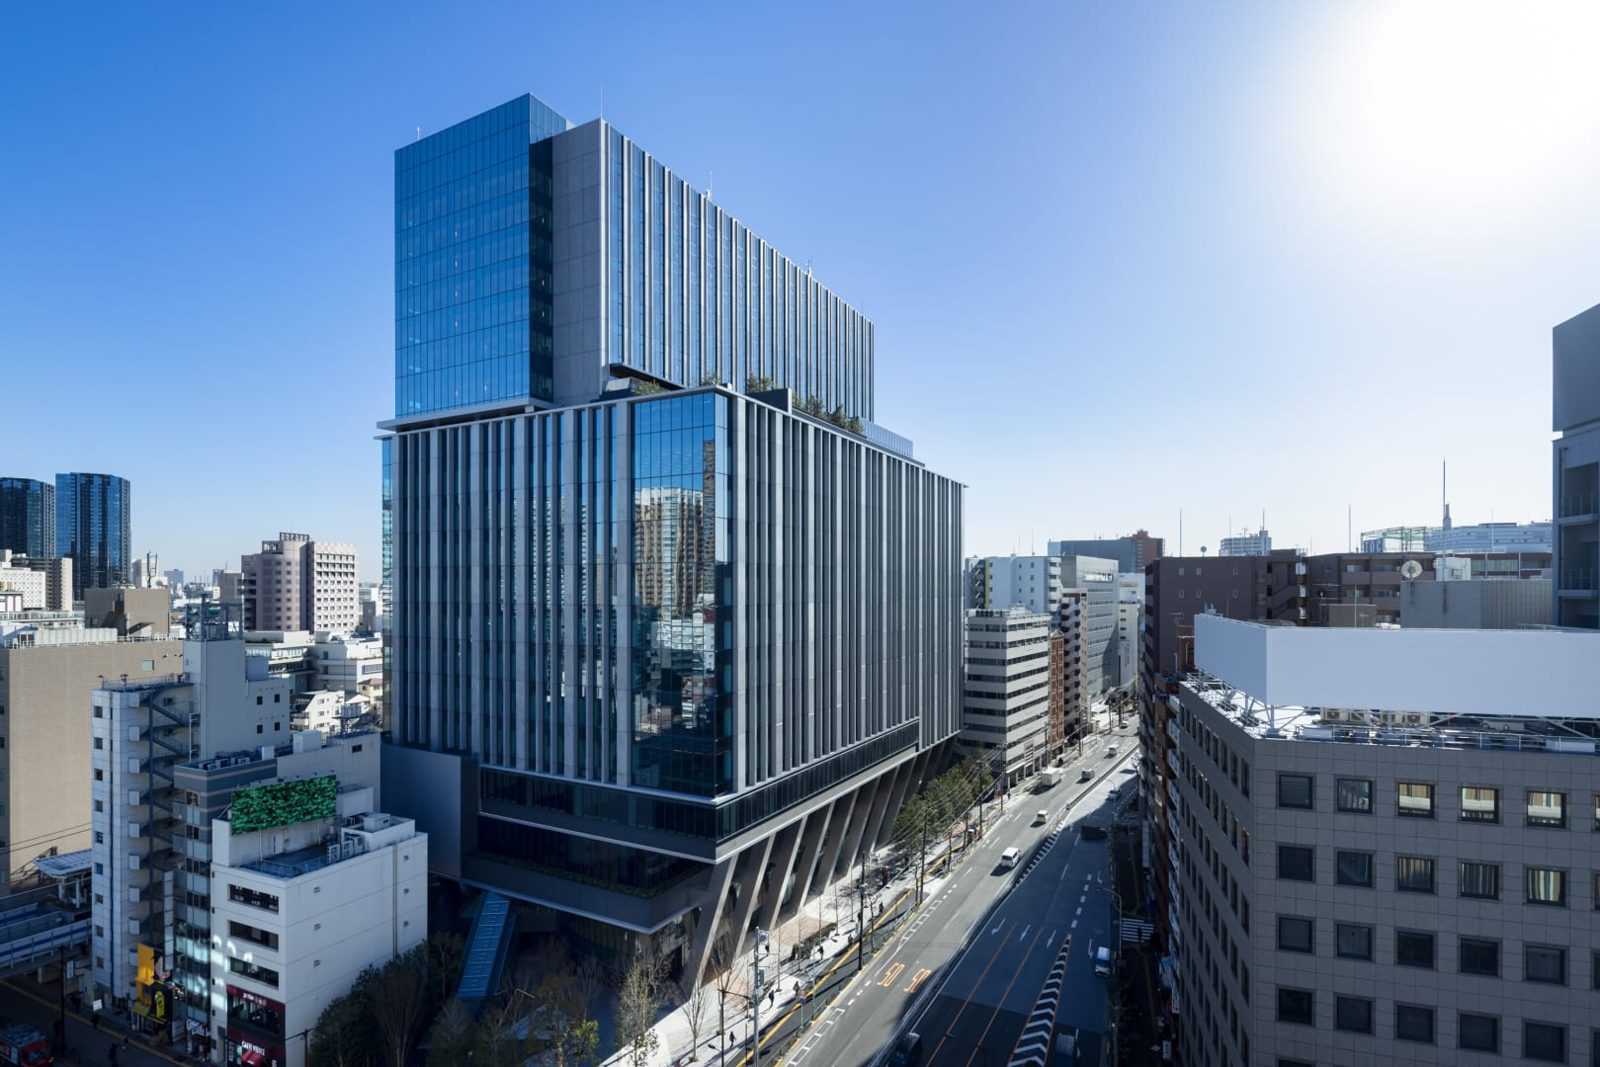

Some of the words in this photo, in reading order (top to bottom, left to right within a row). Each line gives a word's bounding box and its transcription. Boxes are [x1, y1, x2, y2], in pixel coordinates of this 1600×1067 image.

[1365, 540, 1382, 553] TOC
[877, 963, 905, 986] 50
[904, 969, 931, 992] 50
